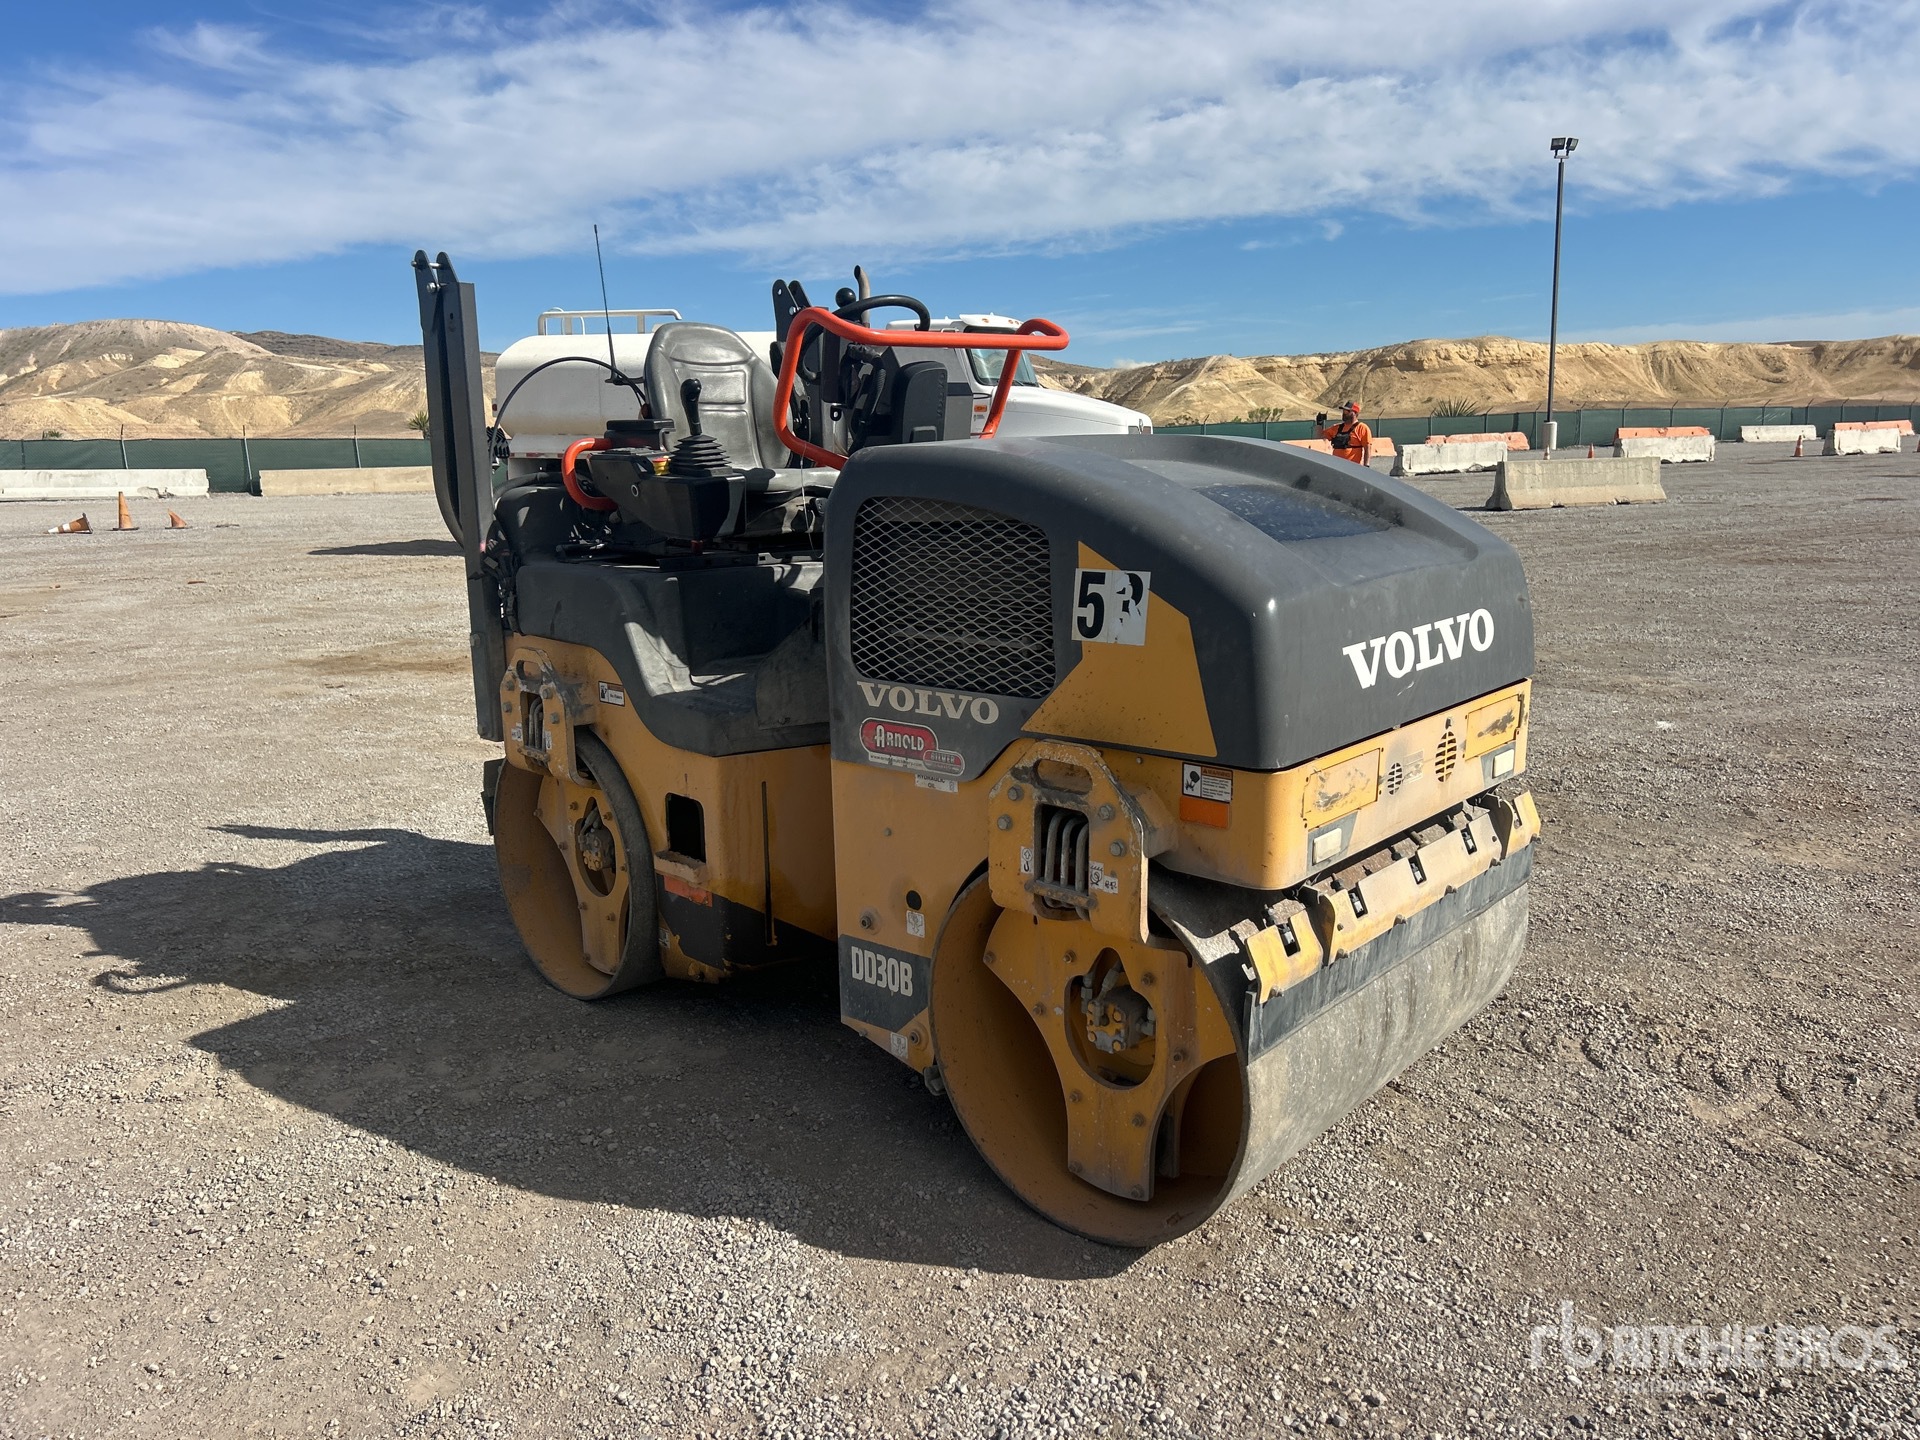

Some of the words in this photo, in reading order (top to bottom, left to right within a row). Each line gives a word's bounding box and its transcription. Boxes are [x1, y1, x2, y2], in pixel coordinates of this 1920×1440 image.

[1341, 608, 1495, 690] VOLVO
[857, 680, 999, 725] VOLVO
[874, 724, 925, 751] ARNOLD
[851, 946, 913, 997] DD30B
